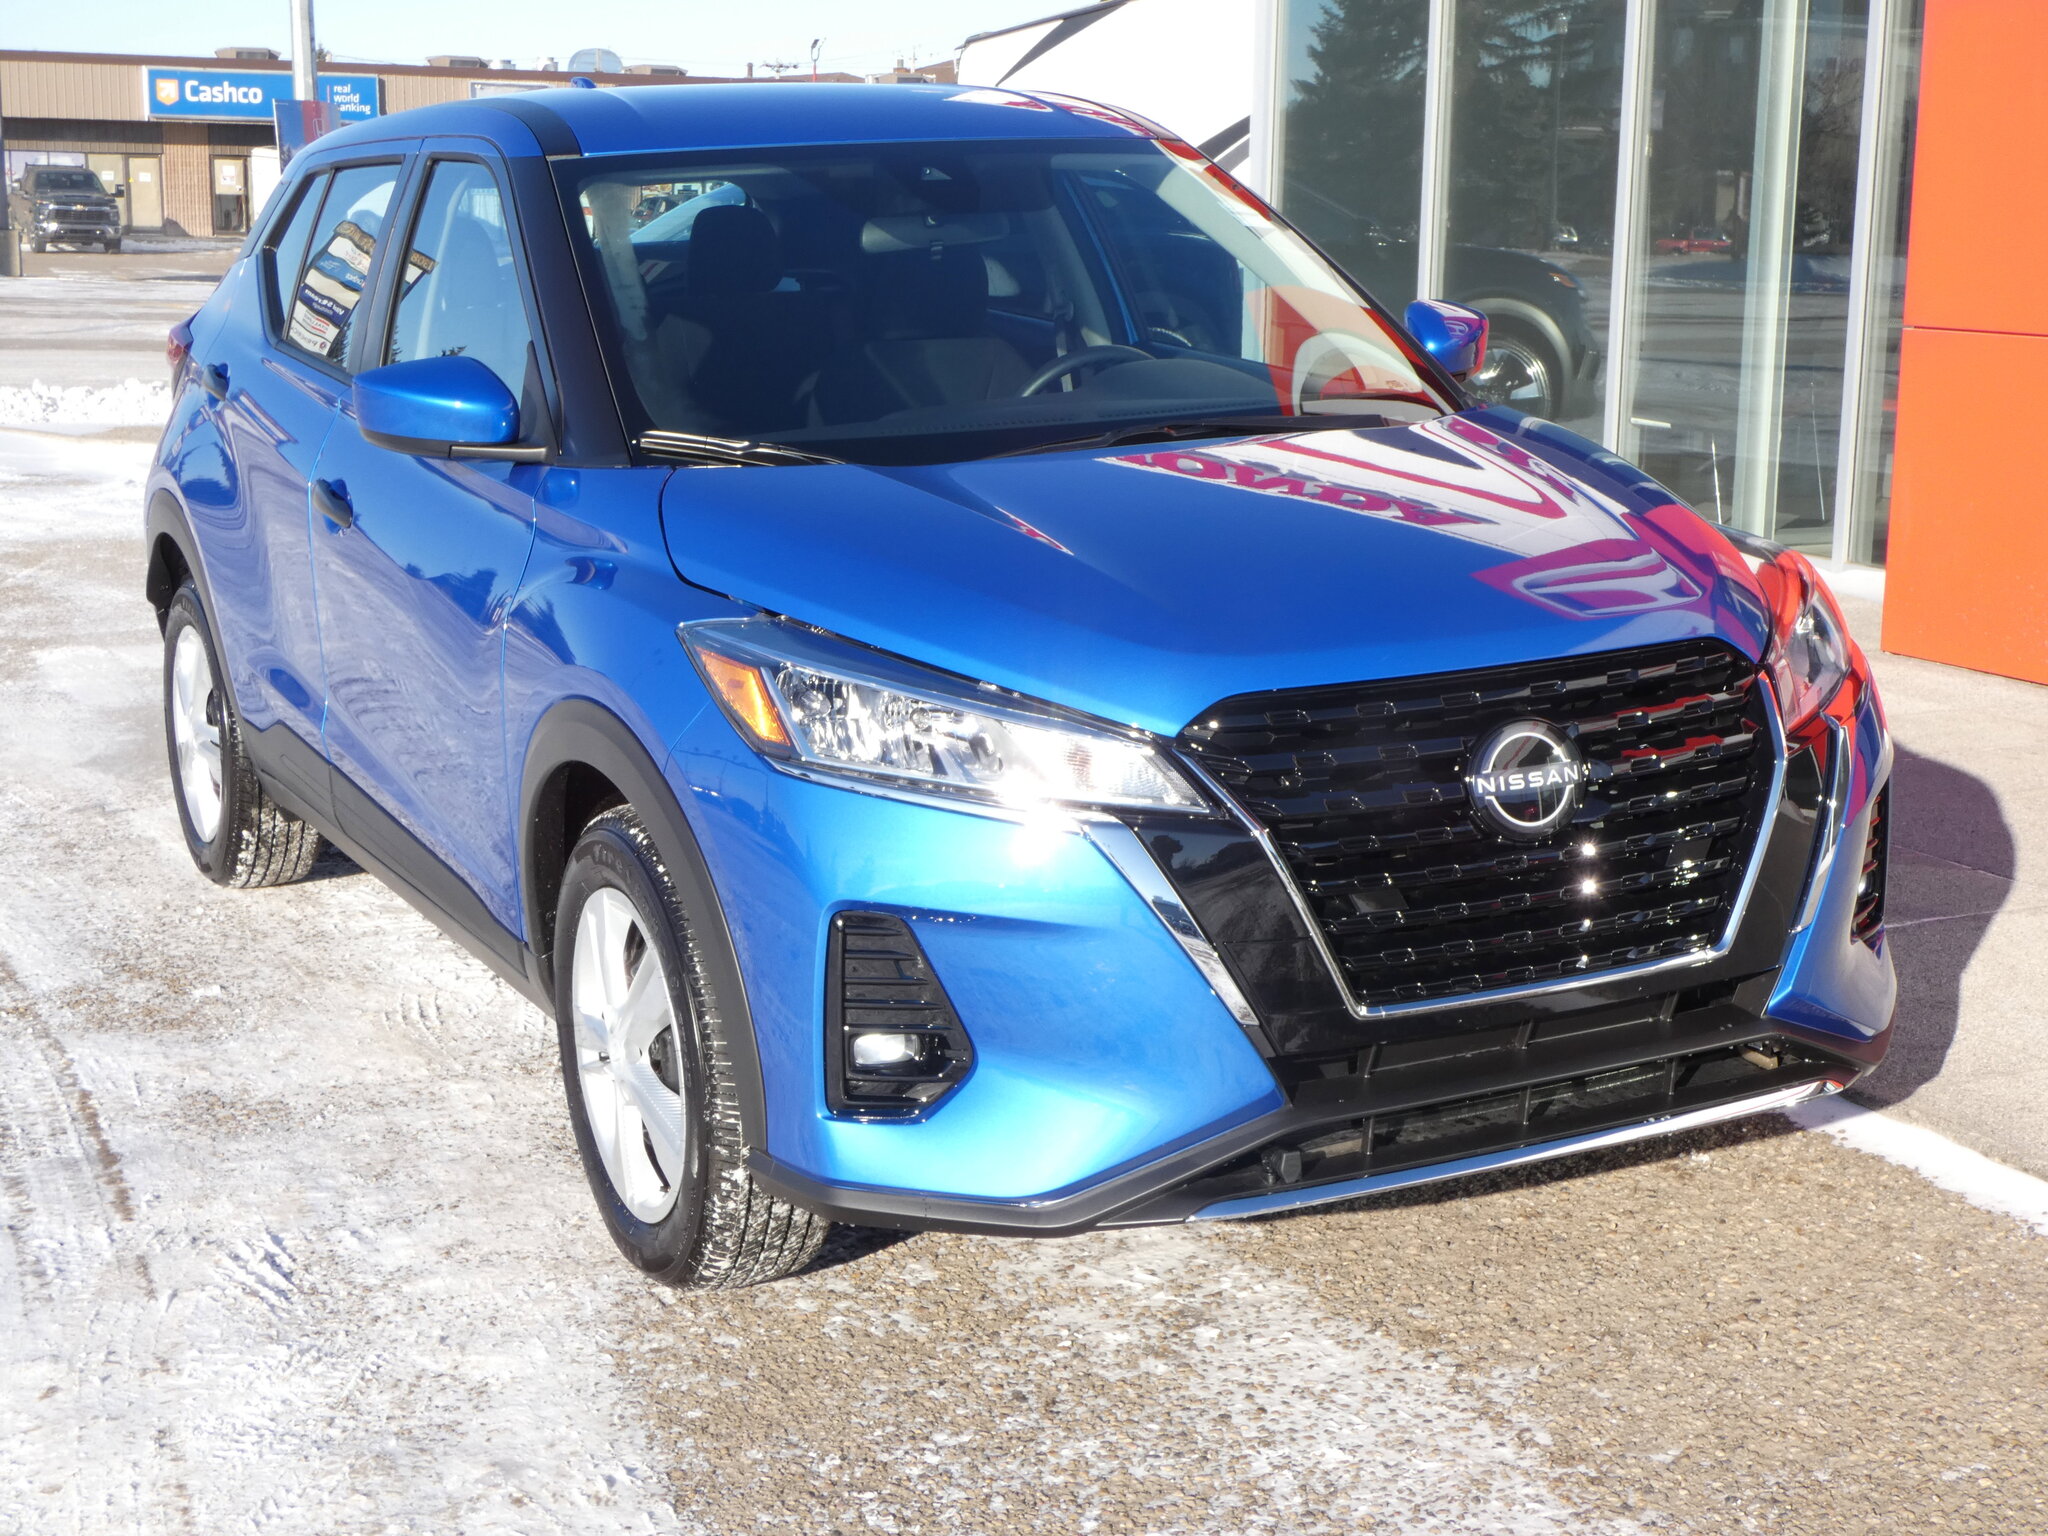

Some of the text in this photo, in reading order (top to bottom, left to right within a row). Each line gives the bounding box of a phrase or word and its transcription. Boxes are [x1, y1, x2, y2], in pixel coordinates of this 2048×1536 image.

[184, 80, 263, 104] Cashco
[333, 84, 351, 94] real
[333, 93, 360, 103] world
[1476, 764, 1580, 794] NISSAN
